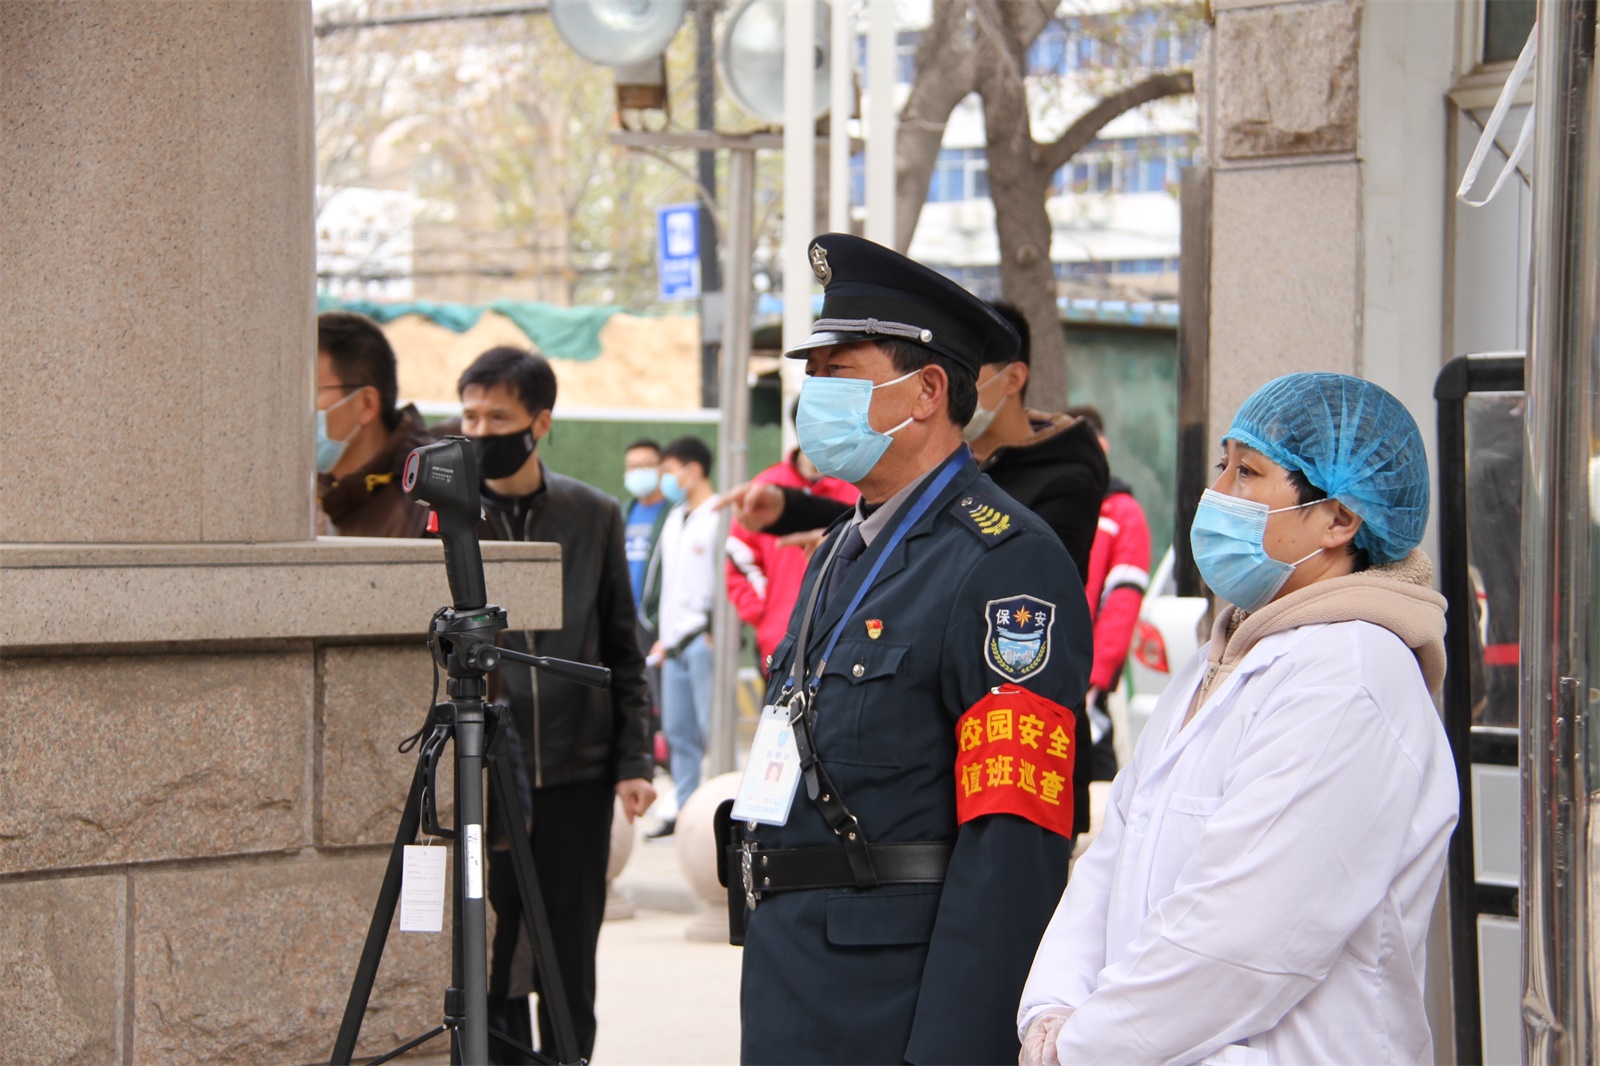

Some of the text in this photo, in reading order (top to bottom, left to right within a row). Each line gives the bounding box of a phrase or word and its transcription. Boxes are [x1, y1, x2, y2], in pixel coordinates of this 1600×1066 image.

[960, 709, 1071, 759] 校园安全
[961, 755, 1066, 805] 值班巡查
